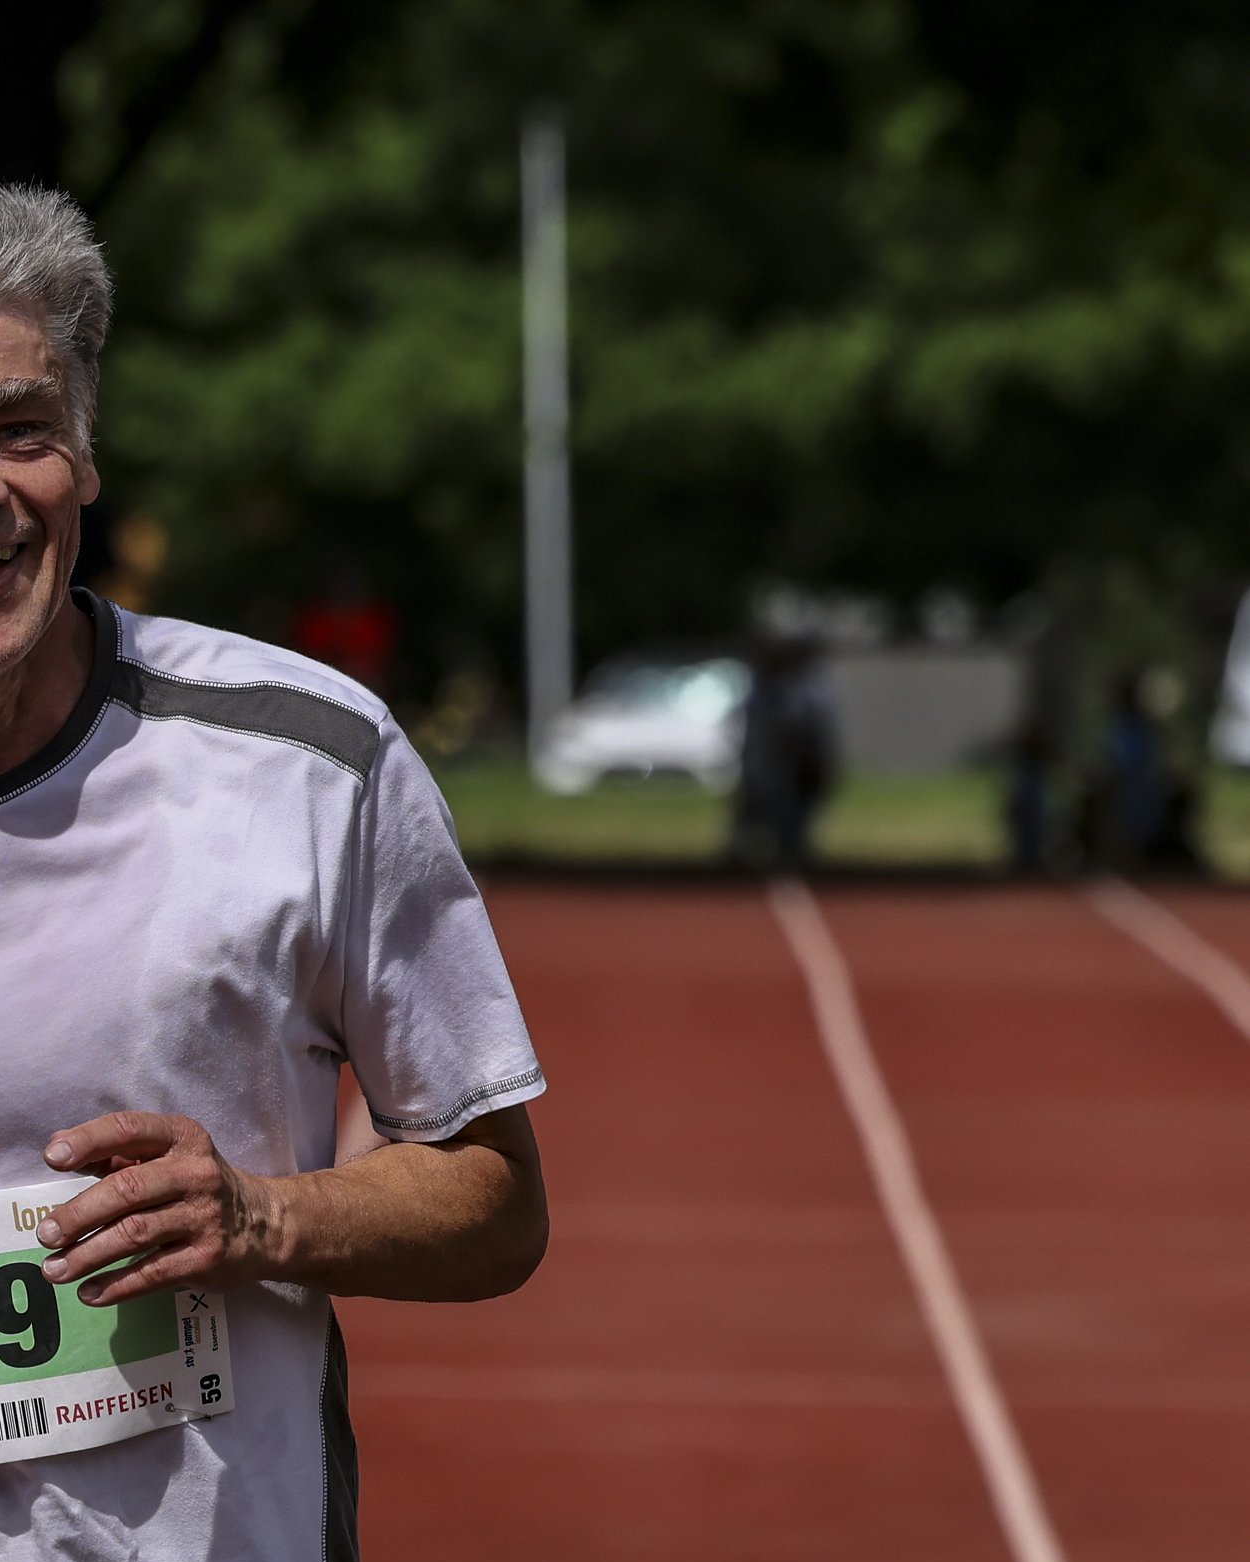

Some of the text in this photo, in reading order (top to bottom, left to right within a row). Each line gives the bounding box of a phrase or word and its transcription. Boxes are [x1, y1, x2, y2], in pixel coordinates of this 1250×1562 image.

[12, 1201, 63, 1232] lon
[181, 1317, 195, 1348] gampel
[210, 1315, 219, 1352] Essensbon
[55, 1381, 174, 1425] RAIFFEISEN
[200, 1373, 222, 1406] 59
